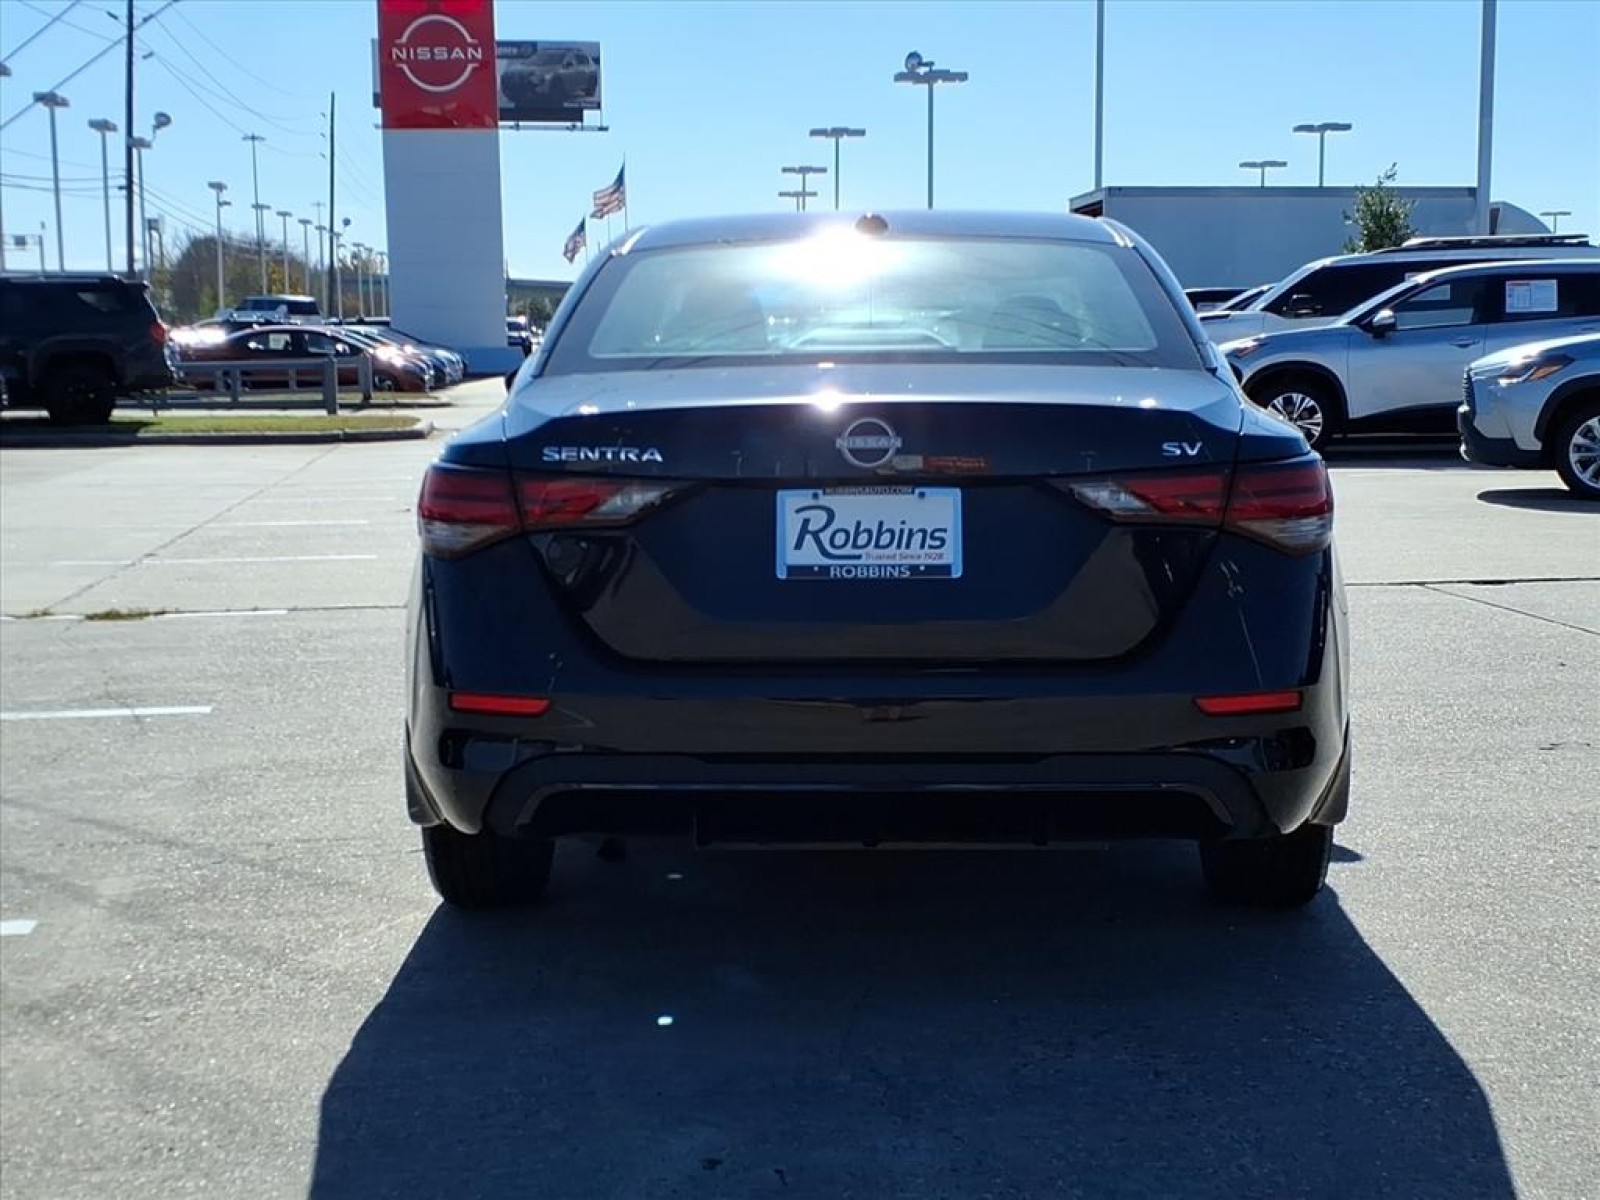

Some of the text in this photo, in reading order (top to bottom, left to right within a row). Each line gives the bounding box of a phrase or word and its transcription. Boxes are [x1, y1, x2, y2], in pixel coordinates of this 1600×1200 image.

[391, 46, 482, 60] NISSAN
[542, 446, 664, 462] SENTRA
[1161, 441, 1203, 456] SV
[793, 504, 948, 560] Robbins
[829, 564, 911, 578] ROBBINS
